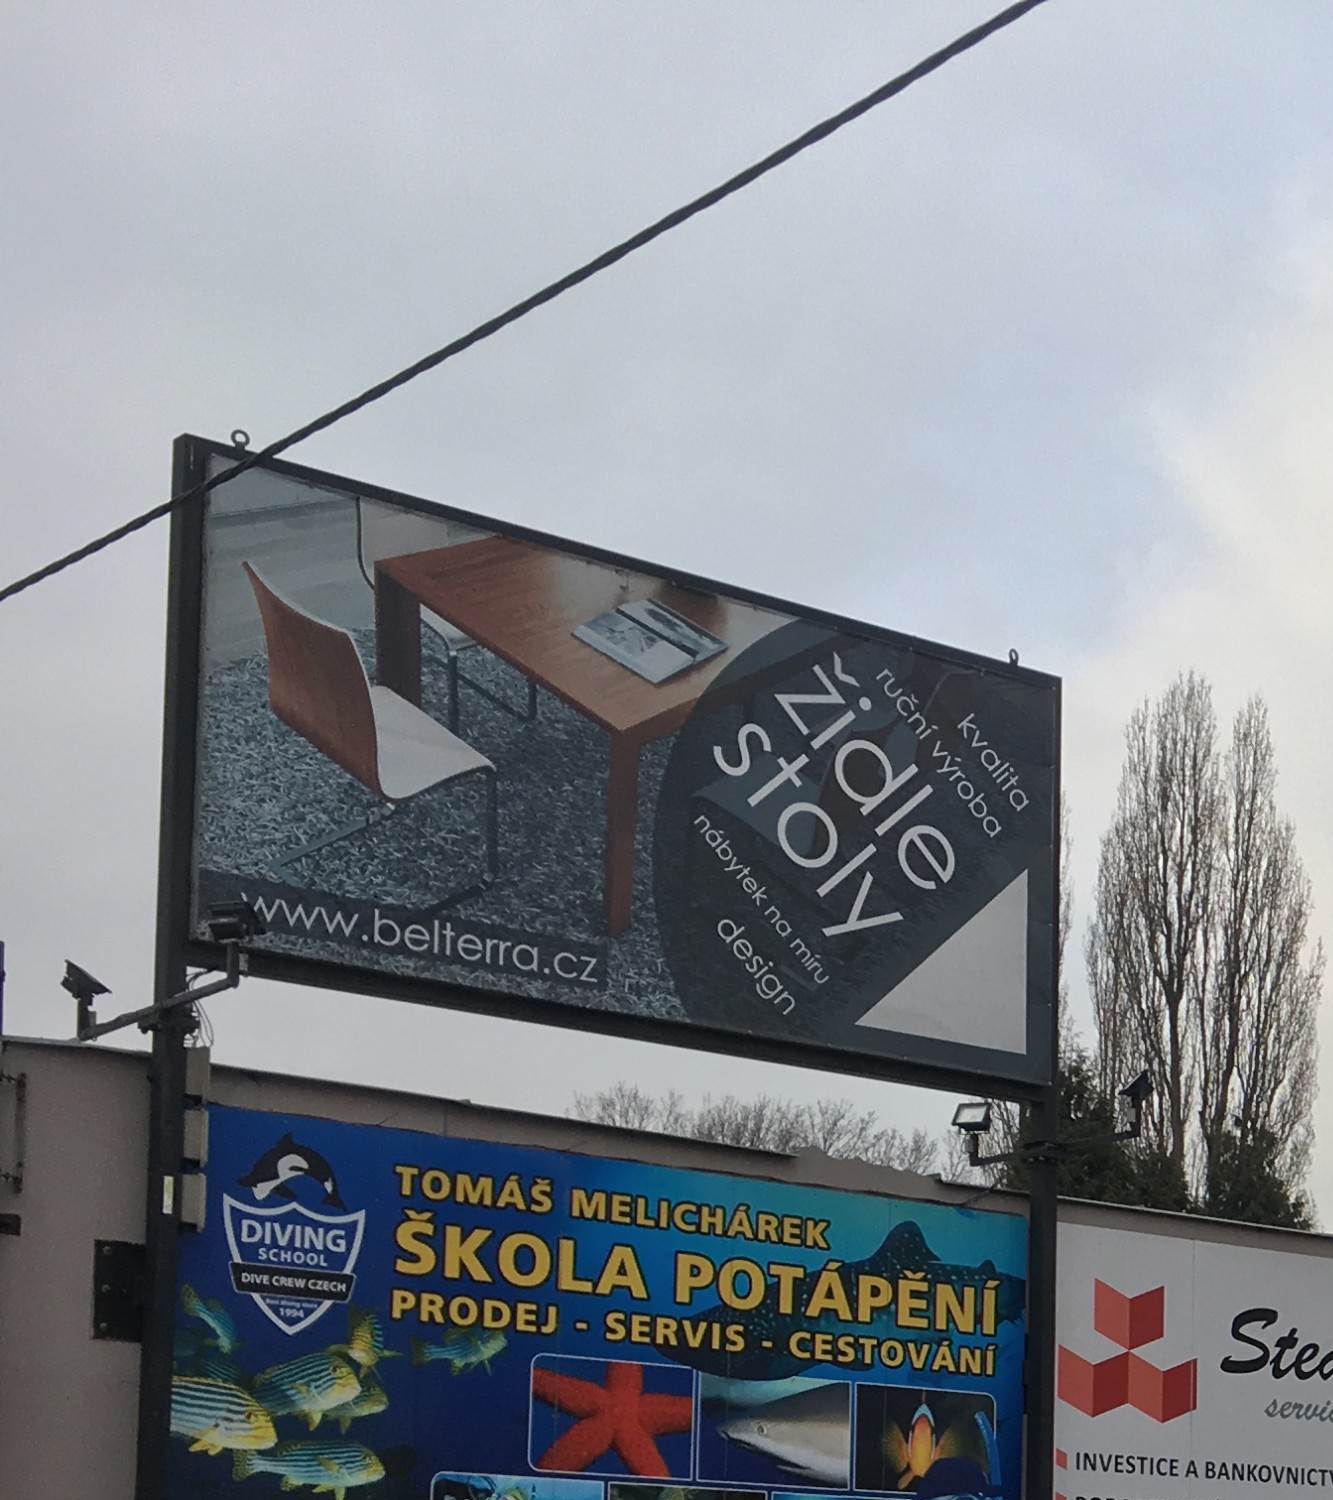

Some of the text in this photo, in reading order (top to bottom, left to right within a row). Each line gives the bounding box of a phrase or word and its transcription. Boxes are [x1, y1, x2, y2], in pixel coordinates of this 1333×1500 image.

[774, 652, 955, 889] židle
[875, 668, 1002, 837] ruční výroba
[958, 713, 1029, 811] kvalita
[713, 723, 903, 936] stoly
[241, 892, 599, 983] www.belterra.cz
[694, 815, 829, 984] nábytek na míru
[717, 919, 796, 1015] design
[240, 1219, 346, 1253] DIVING
[395, 1165, 832, 1250] TOMÁŠ MELICHÁREK
[241, 1271, 346, 1293] DIVE CREW CZECH
[258, 1248, 328, 1267] SCHOOL
[394, 1208, 1000, 1336] ŠKOLA POTÁPĚNÍ
[391, 1289, 997, 1376] PRODEJ SERVIS CESTOVÁNÍ
[1075, 1452, 1180, 1477] INVESTICE
[1185, 1459, 1199, 1479] A
